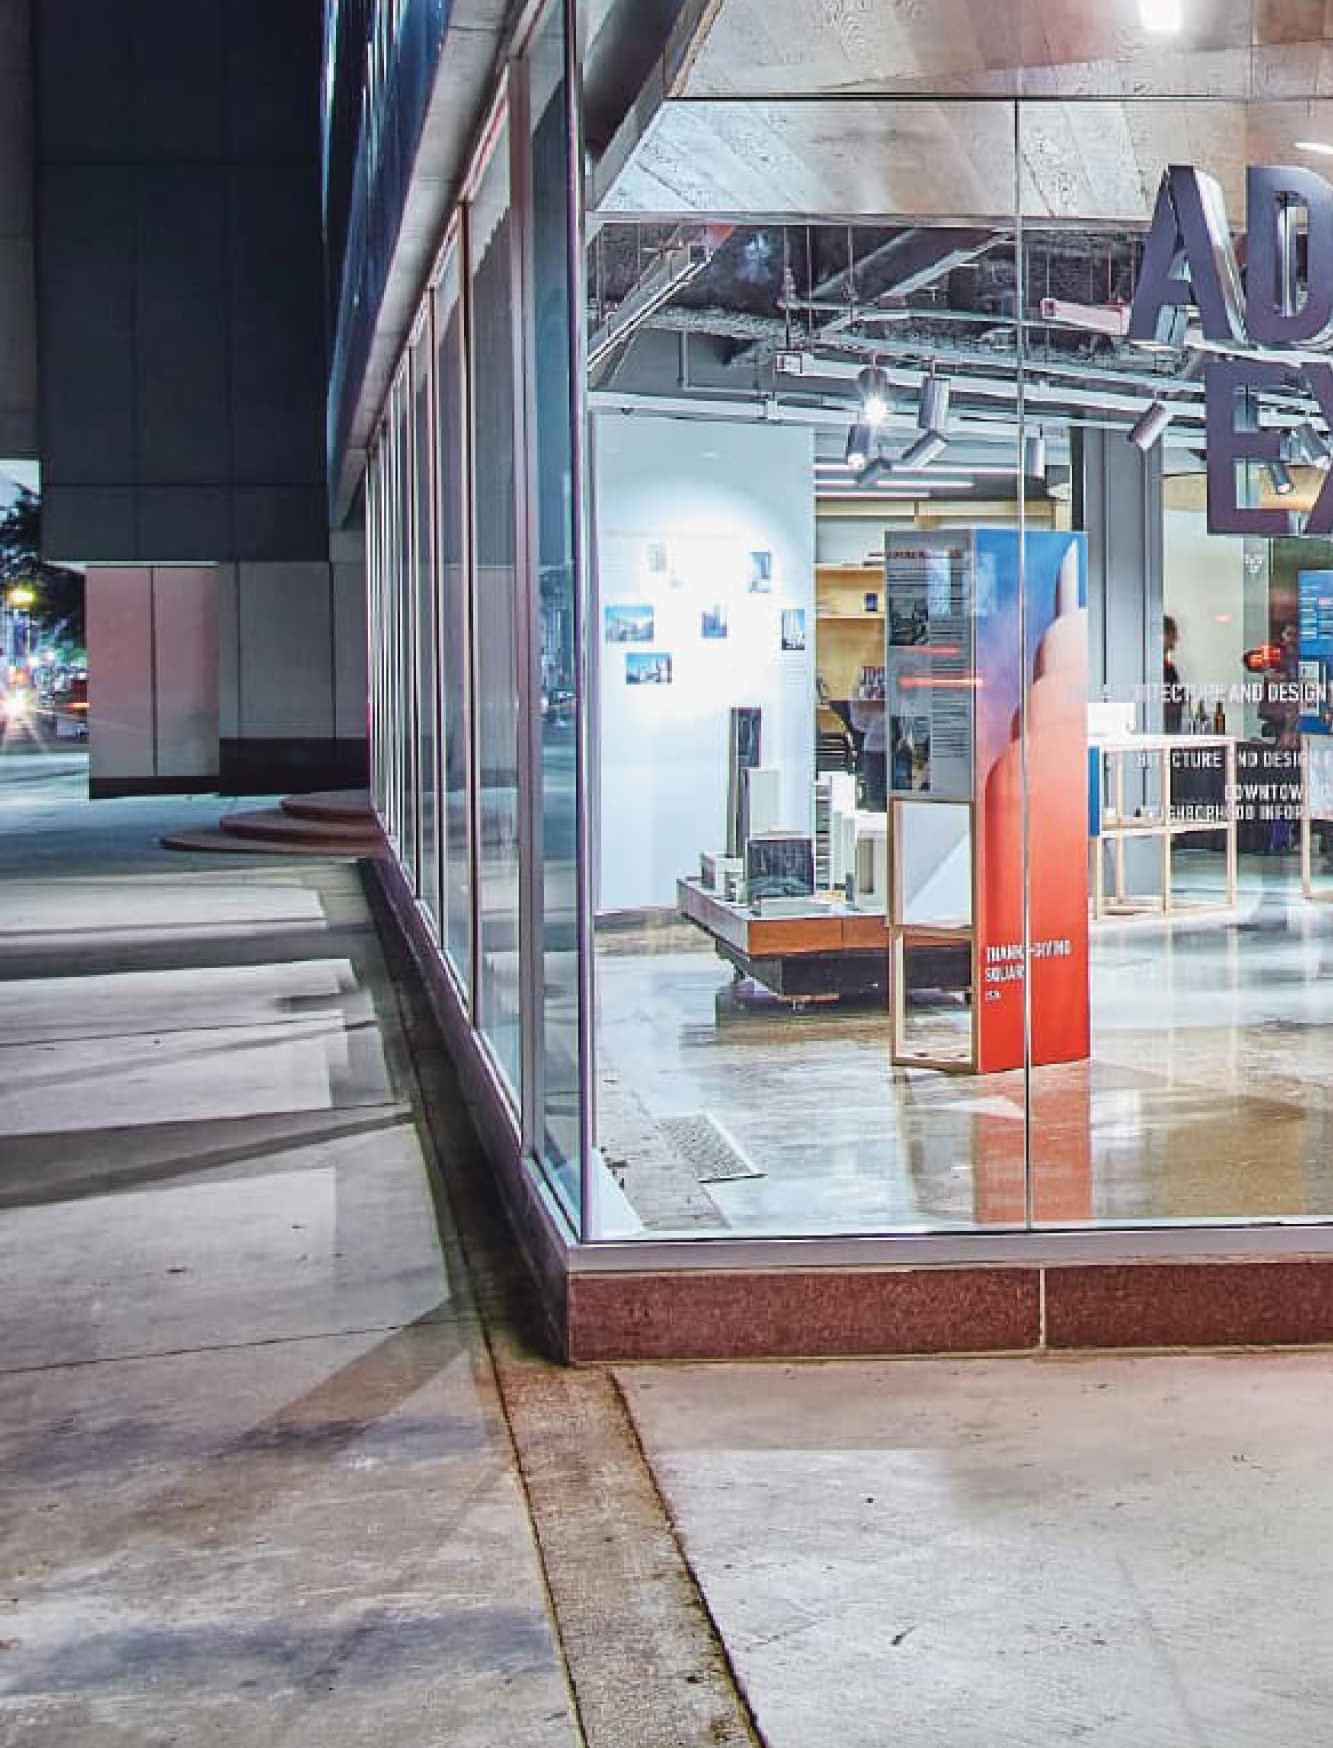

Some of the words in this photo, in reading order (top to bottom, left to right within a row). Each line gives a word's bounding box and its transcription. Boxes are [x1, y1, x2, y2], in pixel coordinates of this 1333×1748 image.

[1229, 683, 1264, 702] AND
[1268, 683, 1327, 702] DESIGN
[1225, 783, 1310, 801] DOWNTOW
